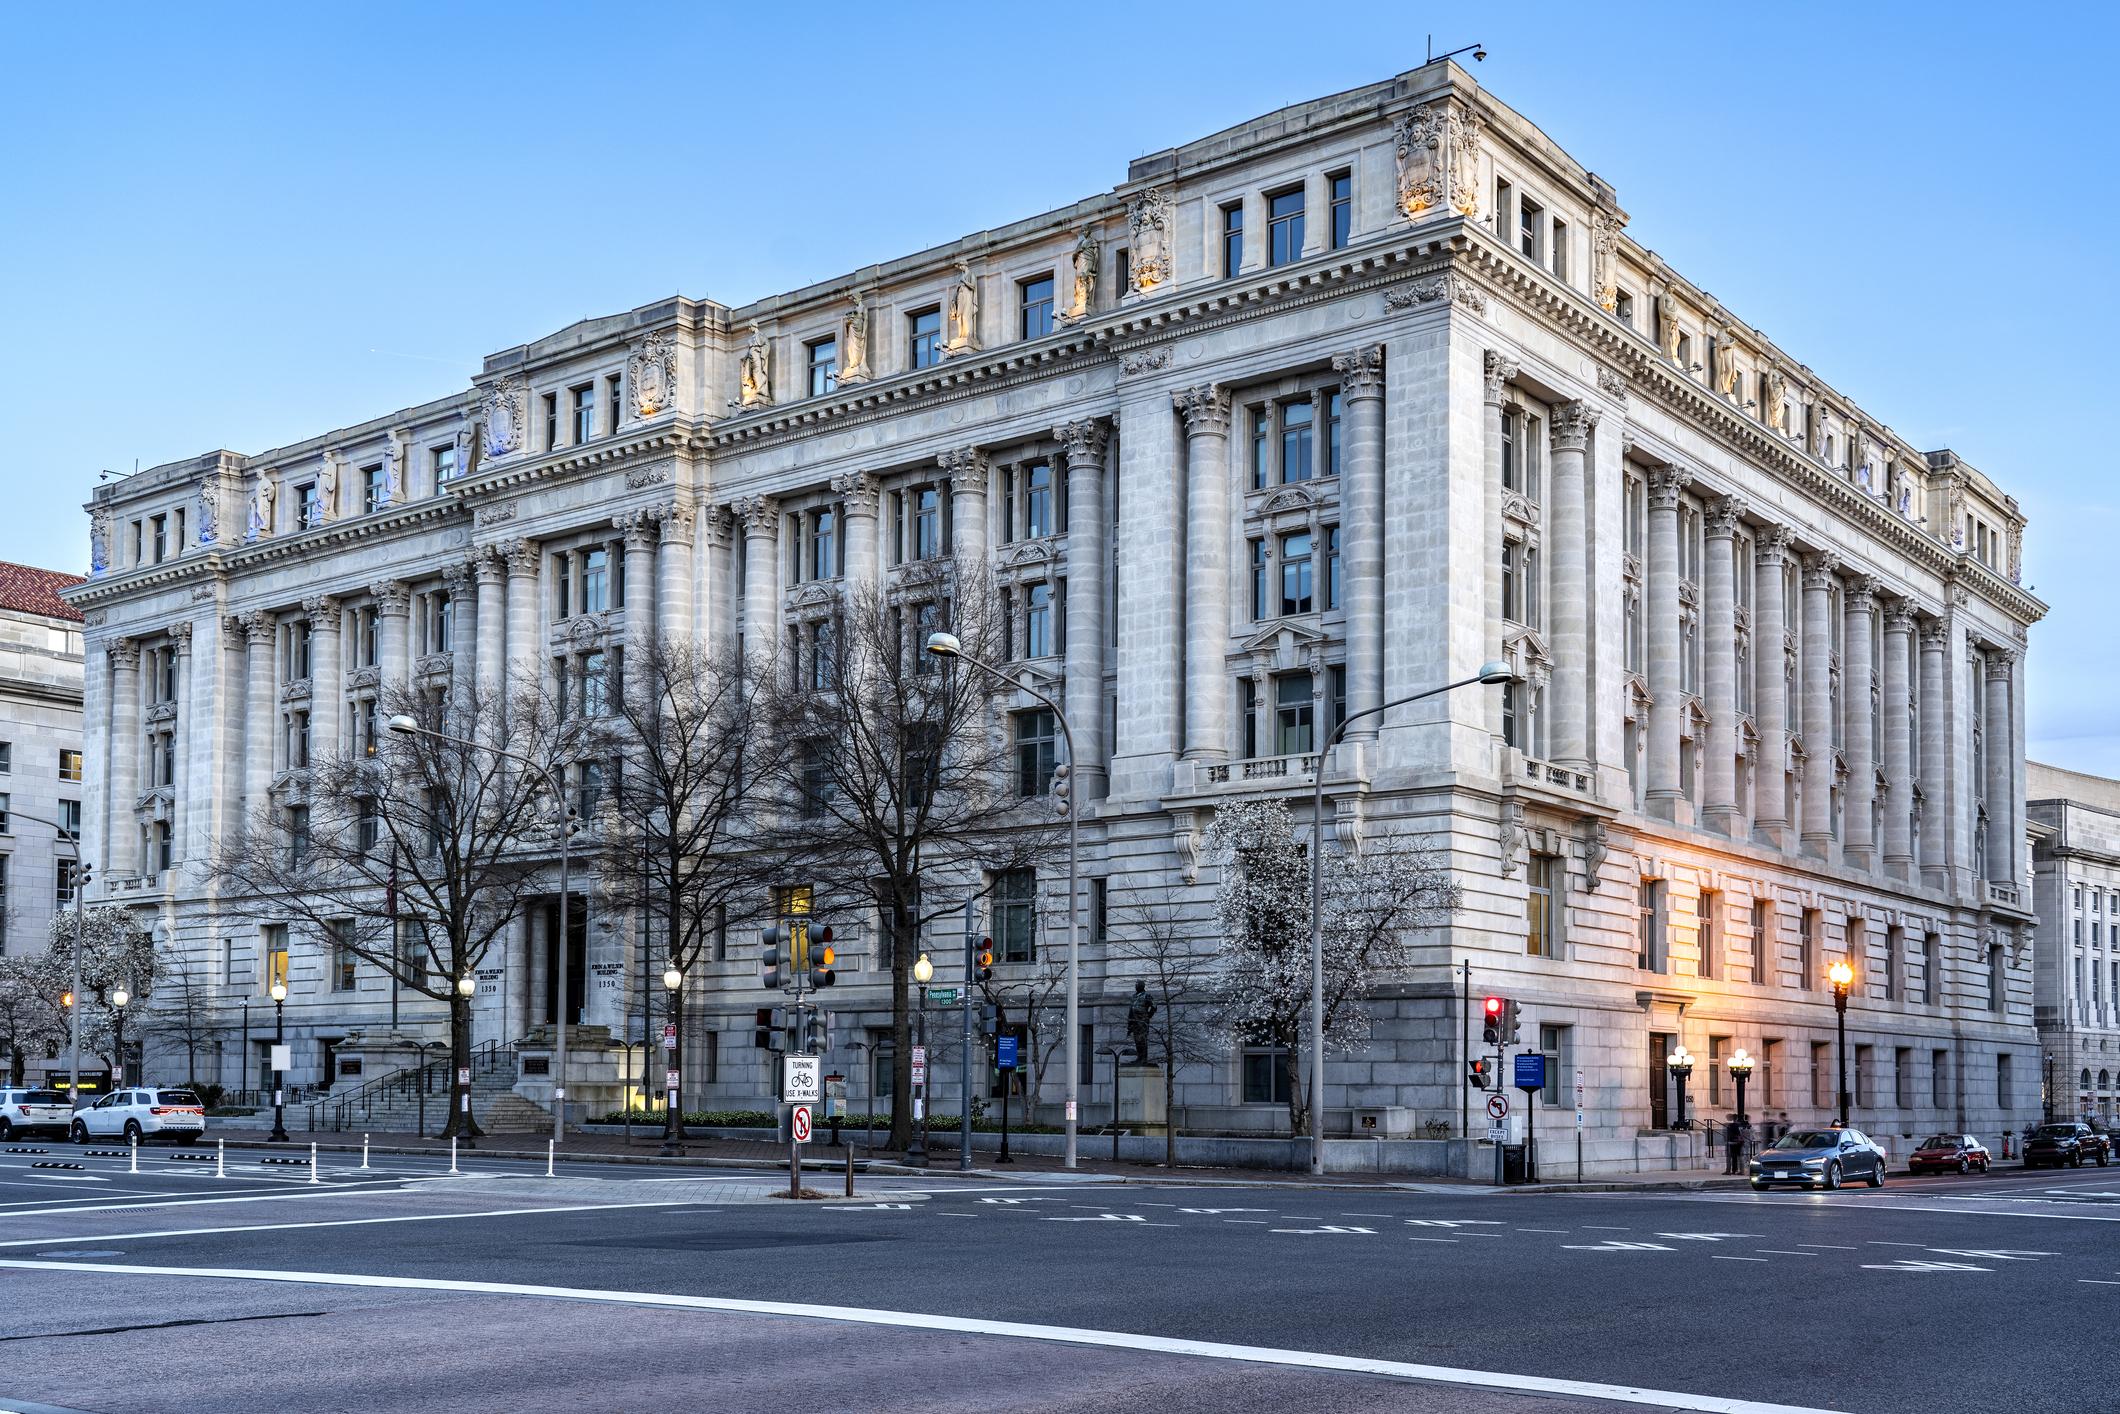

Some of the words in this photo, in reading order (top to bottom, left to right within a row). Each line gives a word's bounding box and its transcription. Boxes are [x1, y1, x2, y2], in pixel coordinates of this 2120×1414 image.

[599, 980, 616, 988] 1350
[929, 990, 952, 999] Pennsylvania
[792, 1061, 813, 1069] TURNING
[797, 1089, 818, 1097] X-WALKS
